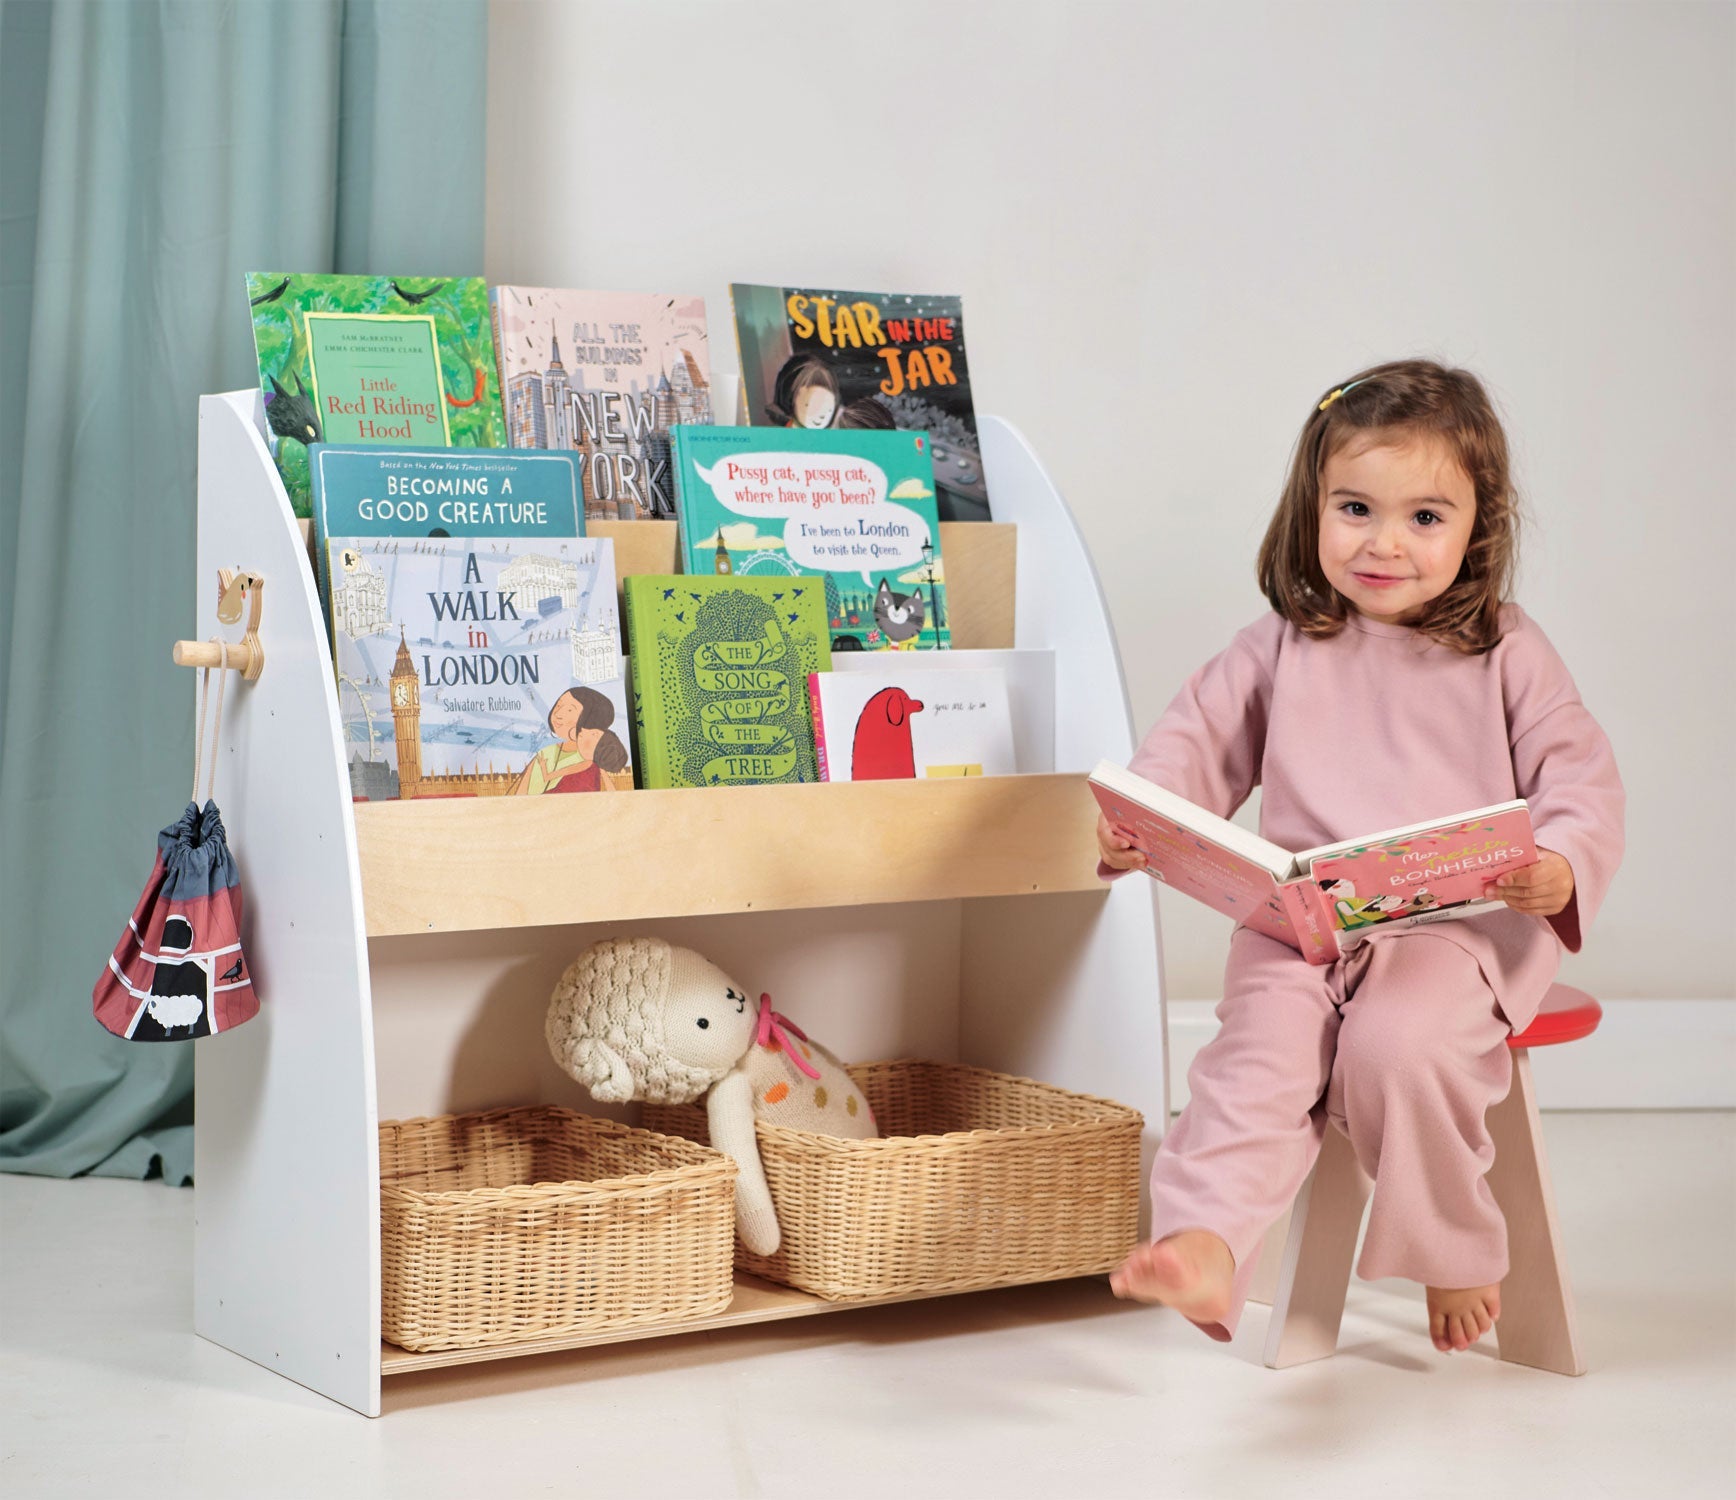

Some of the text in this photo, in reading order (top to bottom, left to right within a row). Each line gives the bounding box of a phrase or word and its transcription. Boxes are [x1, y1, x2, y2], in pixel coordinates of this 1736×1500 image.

[786, 295, 954, 348] STAR IN THE
[341, 334, 357, 342] SAM
[572, 322, 642, 344] ALL THE
[324, 345, 423, 354] EMMA CHICHESTER CLARK
[877, 346, 957, 396] JAR
[360, 378, 397, 391] Little
[328, 396, 437, 424] Red Riding
[571, 392, 659, 445] NEW
[358, 420, 412, 439] Hood
[380, 460, 401, 469] Based
[416, 462, 427, 470] the
[445, 462, 459, 471] York
[462, 463, 481, 471] Times
[484, 464, 518, 472] bestseller
[728, 462, 872, 486] Pussy cat, pussy cat,
[388, 476, 512, 496] BECOMING A
[579, 452, 677, 517] ORK
[735, 486, 875, 509] where have you been?
[358, 498, 548, 524] GOOD CREATURE
[801, 519, 909, 537] I've been to London
[813, 544, 902, 557] to visit the Queen.
[464, 553, 483, 584] A
[426, 590, 521, 622] WALK
[468, 625, 488, 648] in
[726, 647, 752, 659] THE
[422, 654, 540, 686] LONDON
[714, 672, 771, 690] SONG
[444, 696, 521, 712] Salvatore Rubbino
[735, 703, 751, 714] OF
[735, 729, 760, 741] THE
[726, 758, 774, 776] TREE
[1390, 847, 1524, 886] BONHEURS
